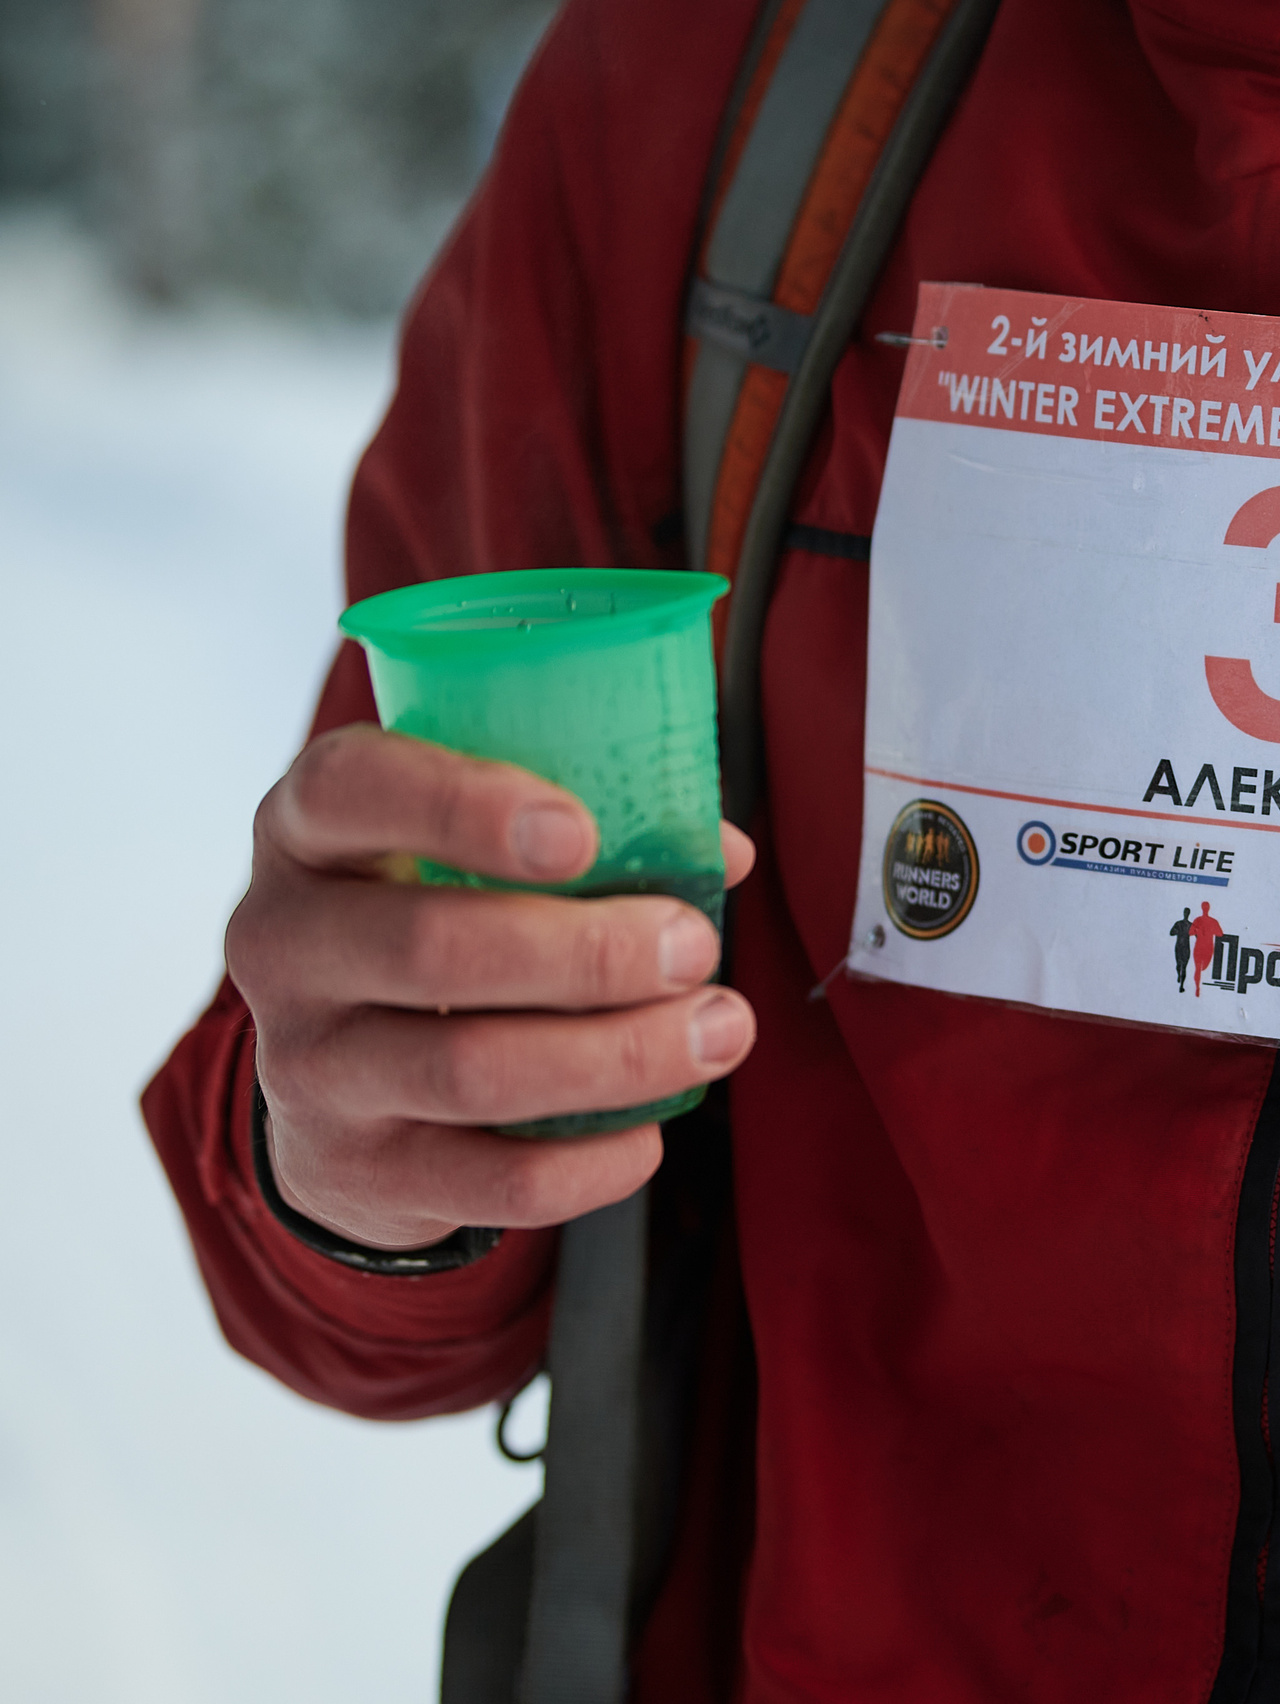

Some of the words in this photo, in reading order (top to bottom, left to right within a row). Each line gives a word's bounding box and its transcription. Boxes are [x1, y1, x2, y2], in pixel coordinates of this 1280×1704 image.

[987, 315, 1048, 359] 2-й
[1058, 333, 1226, 377] зимний
[939, 372, 1079, 426] "WINTER
[1059, 832, 1164, 865] SPORT
[893, 861, 961, 891] RUNNERS
[1130, 869, 1198, 883] ПУЛЬСОМЕТРОВ
[896, 883, 952, 910] WORLD
